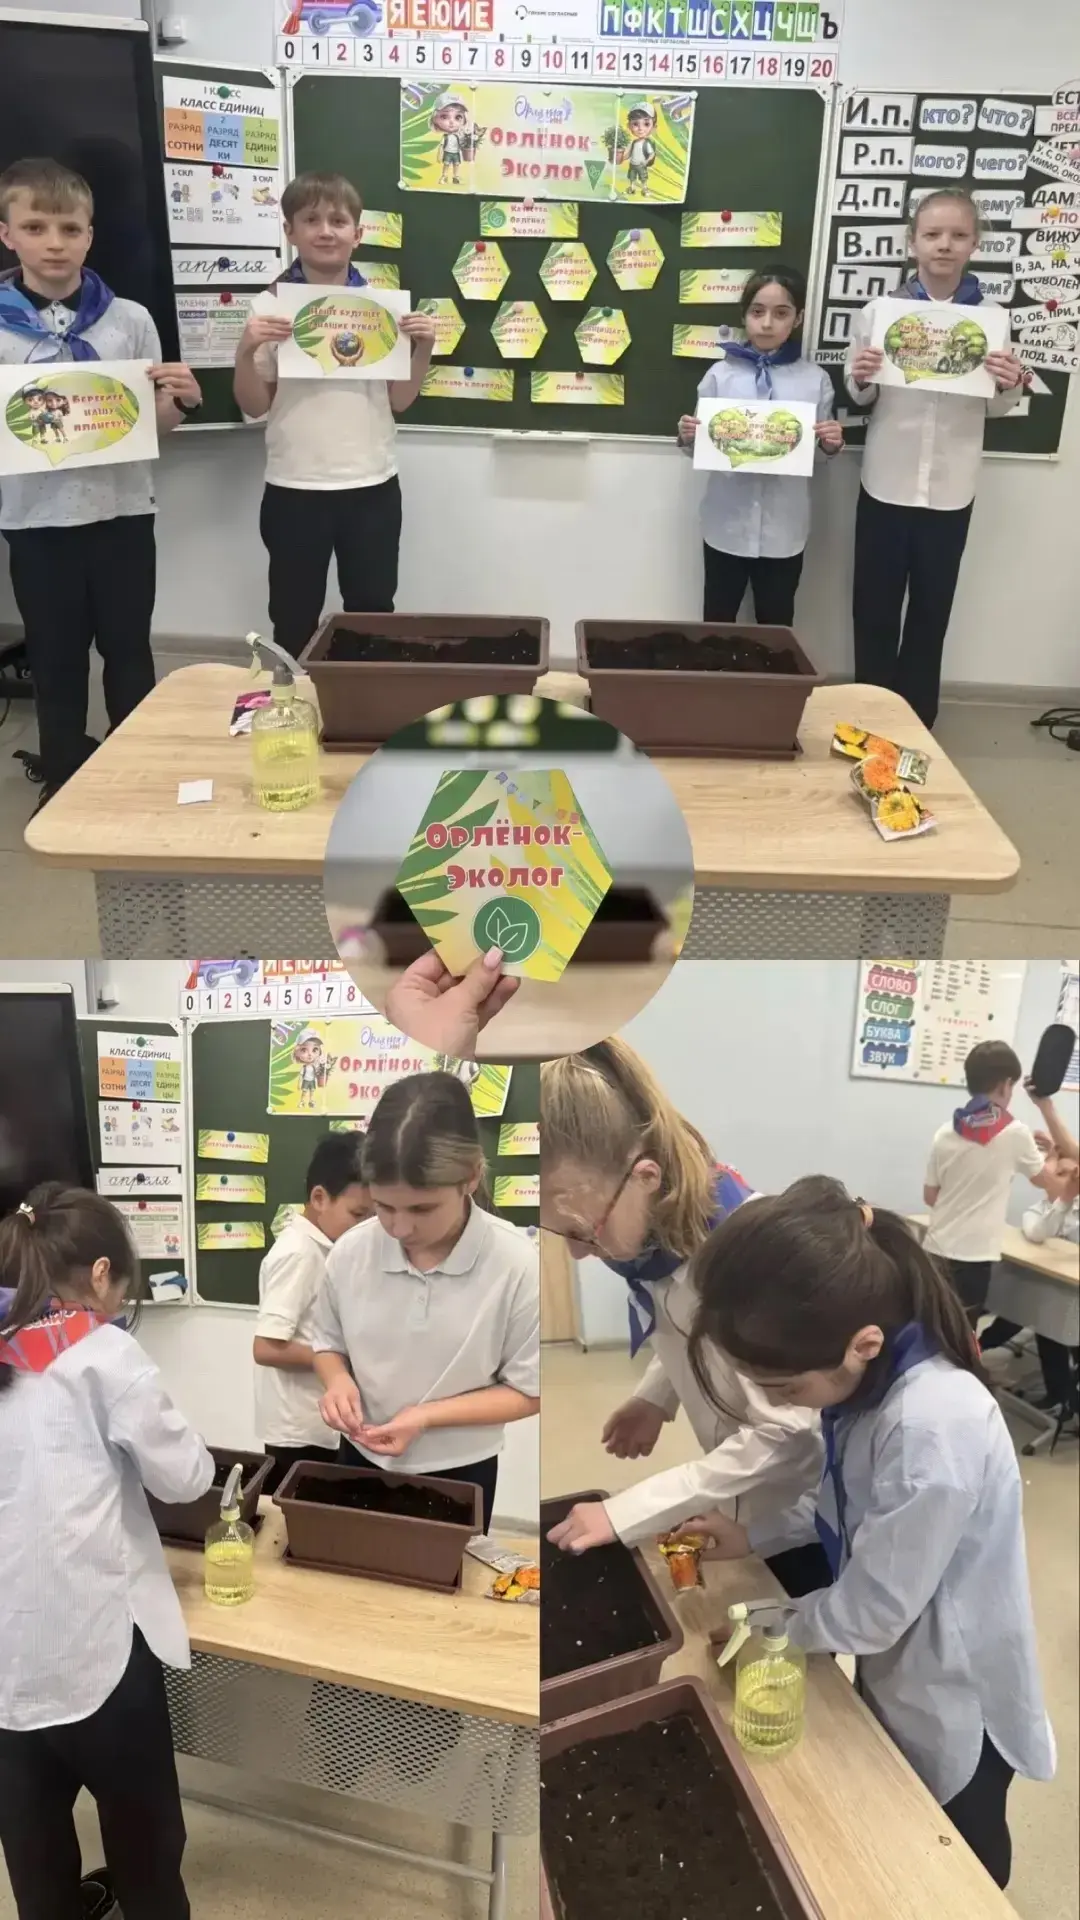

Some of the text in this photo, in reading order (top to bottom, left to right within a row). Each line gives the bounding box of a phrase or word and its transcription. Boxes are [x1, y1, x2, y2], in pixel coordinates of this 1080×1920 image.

[820, 12, 838, 39] Ъ
[285, 41, 832, 77] 0 1 2 3 4 5 6 7 8 9 10 11 12 13 14 15 16 17 18 19 20
[210, 87, 242, 98] КСС
[180, 97, 265, 117] КЛАСС ЕДИНИЦ
[845, 97, 909, 126] И.п.
[182, 111, 187, 119] 3
[922, 104, 974, 125] кто?
[981, 107, 1033, 130] что?
[168, 123, 202, 134] РАЗРЯД
[207, 126, 239, 137] РАЗРЯД
[245, 129, 277, 141] РАЗРЯД
[167, 140, 204, 152] СОТНИ
[209, 138, 238, 149] ДЕСЯТ
[245, 142, 277, 153] ЕДИНИ
[217, 151, 230, 160] КИ
[254, 155, 269, 164] ЦЫ
[854, 143, 903, 165] Р.п.
[914, 152, 966, 170] кого?
[502, 158, 583, 179] ЭКОЛОГ
[975, 154, 1028, 171] чего?
[177, 169, 194, 177] СКЛ
[837, 184, 900, 211] Д.п.
[1033, 190, 1075, 207] ДАМ
[1059, 212, 1078, 224] ПО
[1035, 230, 1080, 243] ВИЖУ
[844, 232, 903, 257] В.п.
[1015, 258, 1070, 273] В, ЗА, НА,
[1014, 314, 1025, 324] О,
[1028, 311, 1046, 322] ОБ,
[1051, 354, 1067, 366] ЗА,
[426, 819, 583, 849] ОРЛЁНОК-
[447, 865, 565, 891] ЭКОЛОГ
[871, 975, 912, 992] СЛОВО
[186, 985, 355, 1010] 0 1 2 3 4 5 6 7 8
[871, 1000, 902, 1015] СЛОГ
[866, 1025, 901, 1040] БУКВА
[109, 1047, 171, 1060] КЛАСС ЕДИНИЦ
[868, 1050, 896, 1064] ЗВУК
[101, 1083, 126, 1091] СОТНИ
[130, 1080, 151, 1088] ДЕСЯТ
[156, 1081, 180, 1089] ЕДИНИ
